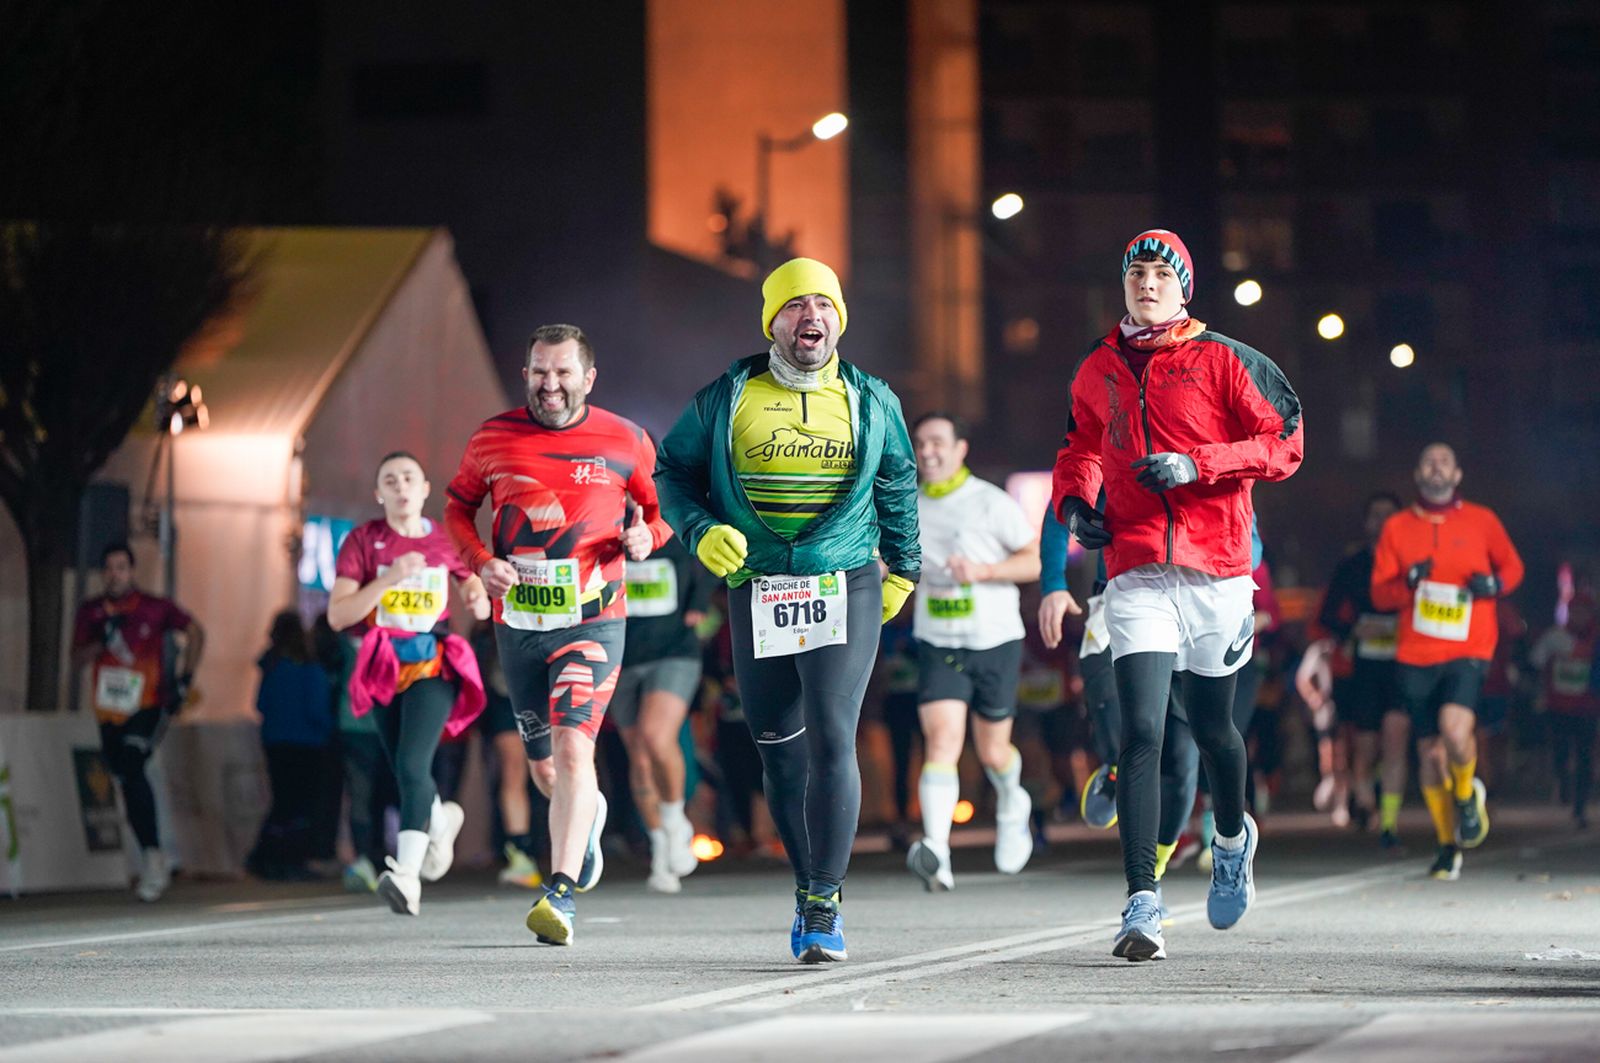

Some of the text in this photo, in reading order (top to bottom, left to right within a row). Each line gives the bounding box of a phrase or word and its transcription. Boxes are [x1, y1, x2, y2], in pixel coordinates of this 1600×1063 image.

[1122, 237, 1191, 288] UNNING
[515, 583, 566, 607] 8009
[771, 580, 810, 591] NOCHE DE
[390, 591, 433, 609] 2326
[761, 594, 779, 604] SAN
[781, 589, 812, 600] ANTÓN
[773, 599, 827, 628] 6718
